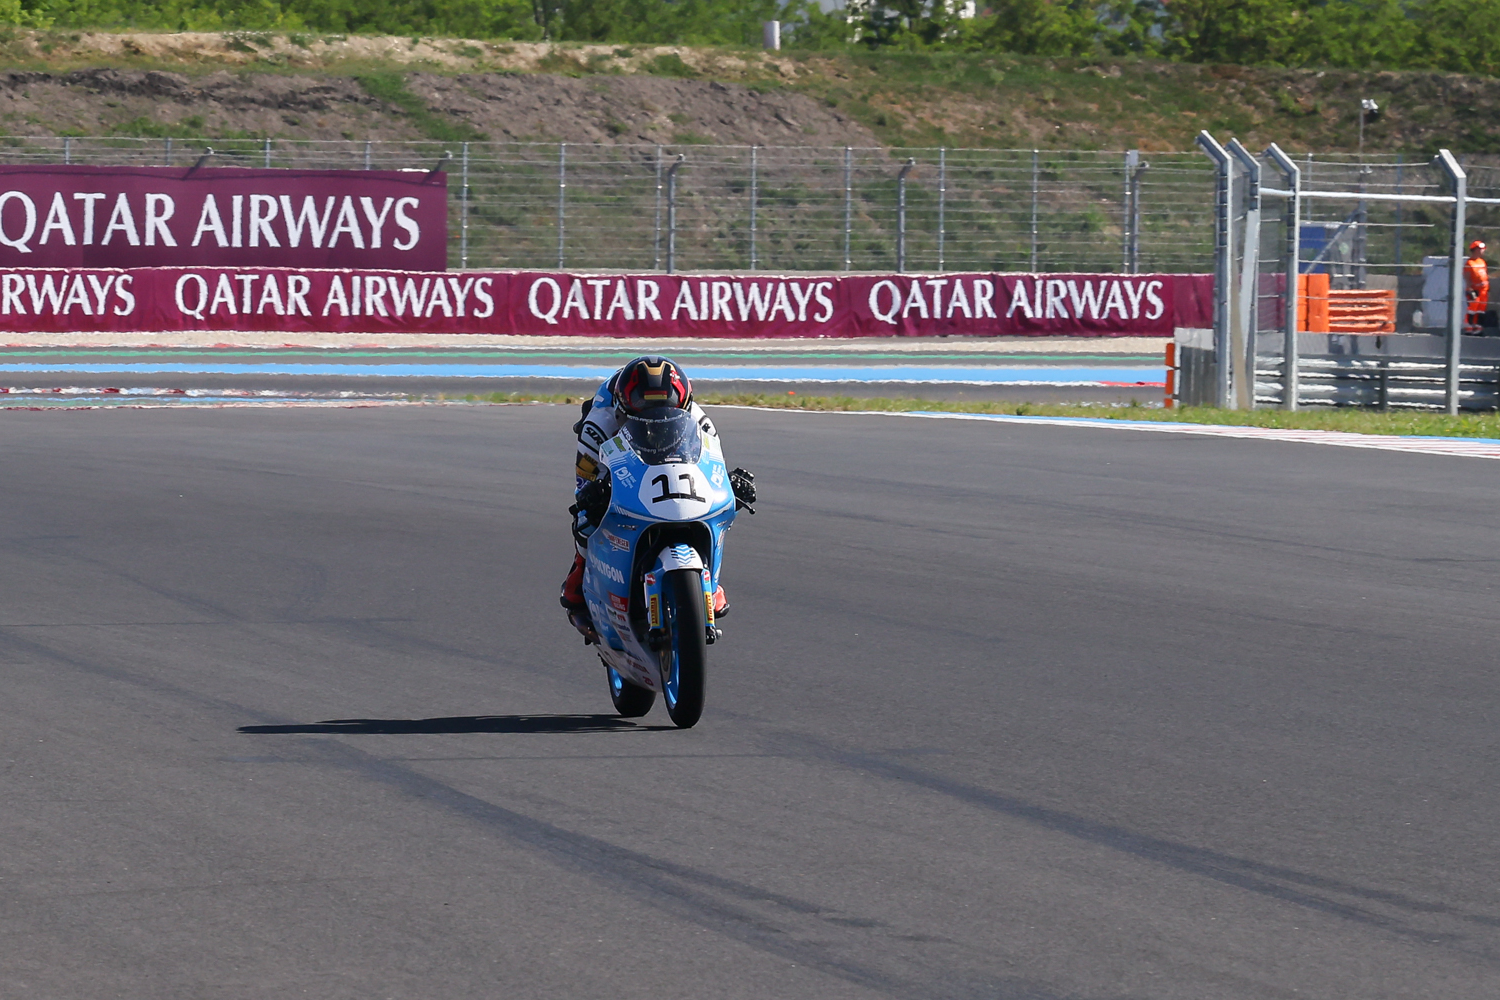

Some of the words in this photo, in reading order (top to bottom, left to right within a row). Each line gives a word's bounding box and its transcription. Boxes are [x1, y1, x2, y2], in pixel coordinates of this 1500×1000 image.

[192, 194, 421, 250] AIRWAYS
[175, 273, 312, 320] QATAR
[322, 275, 494, 318] AIRWAYS
[528, 277, 661, 324] QATAR
[671, 281, 833, 322] AIRWAYS
[869, 279, 997, 324] QATAR
[1006, 280, 1164, 319] AIRWAYS
[652, 473, 706, 503] 11
